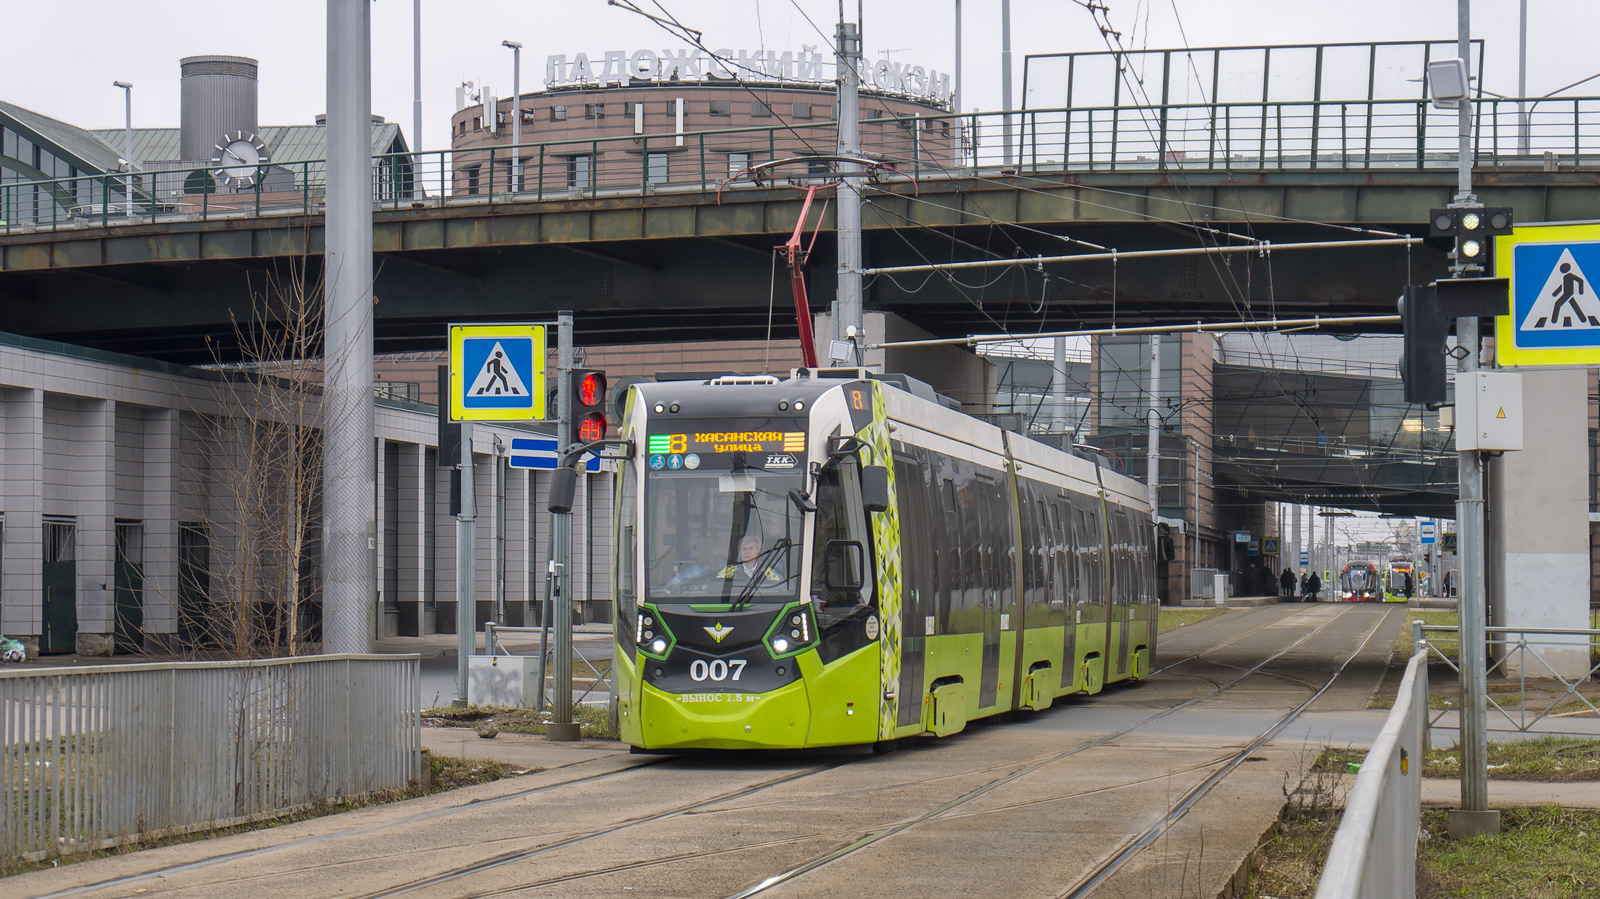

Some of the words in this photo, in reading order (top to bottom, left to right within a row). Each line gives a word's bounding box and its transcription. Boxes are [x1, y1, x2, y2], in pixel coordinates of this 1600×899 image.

[543, 44, 822, 87] ЛАДОЖСКИЙ
[852, 390, 863, 410] 8
[669, 433, 687, 454] 8
[694, 432, 782, 443] ХАСАНСКАЯ
[714, 443, 763, 453] улица
[767, 456, 789, 464] ТКК
[690, 659, 747, 681] 007
[727, 694, 743, 702] 1.5
